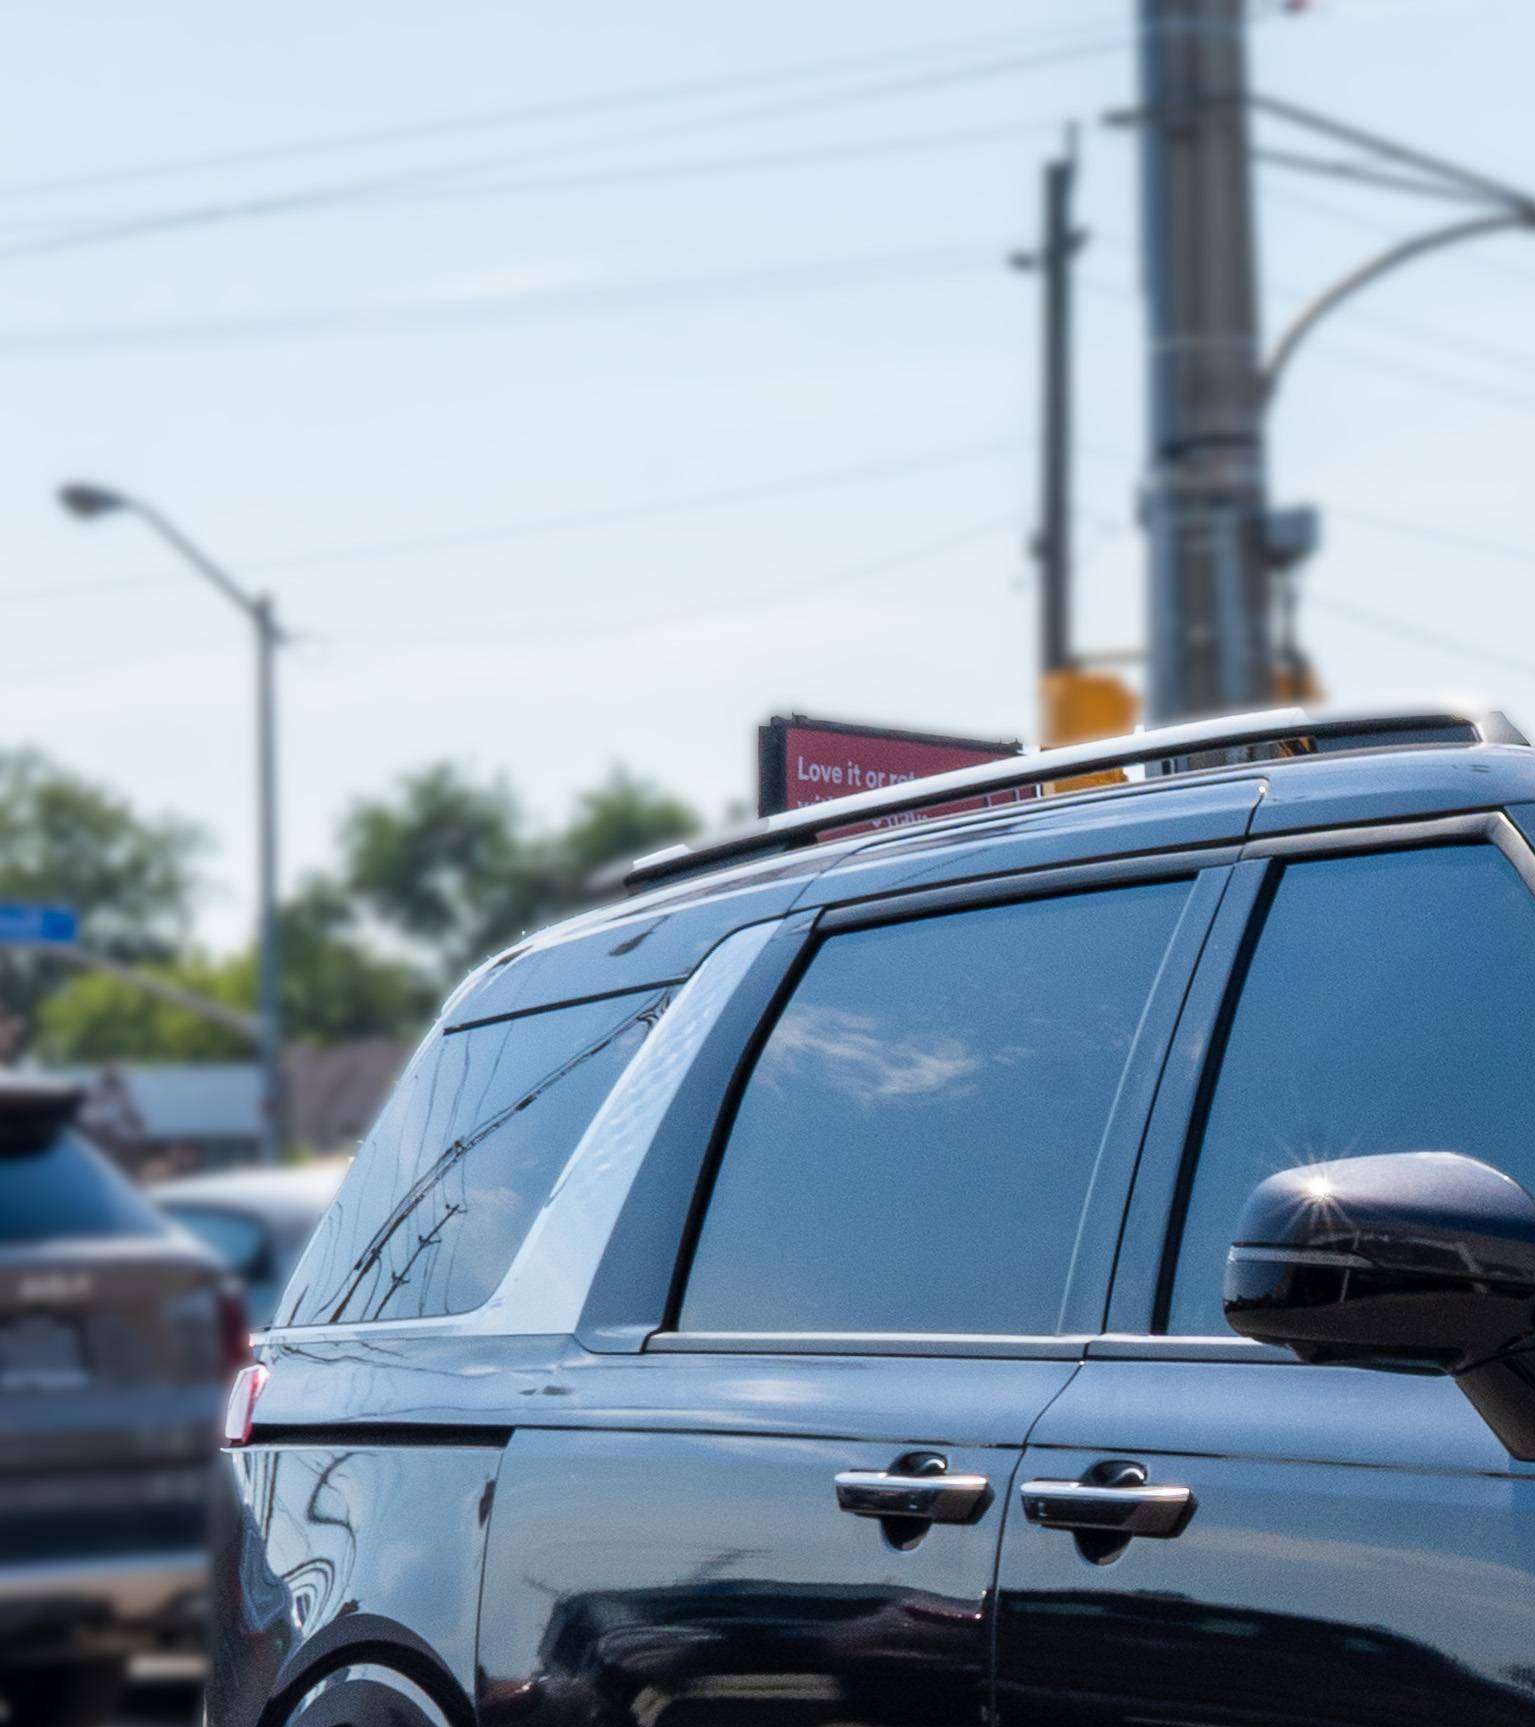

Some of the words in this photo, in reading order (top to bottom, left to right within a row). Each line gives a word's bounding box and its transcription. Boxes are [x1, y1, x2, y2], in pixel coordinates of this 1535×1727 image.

[797, 755, 842, 784] Love
[847, 760, 861, 787] it
[865, 770, 885, 788] or
